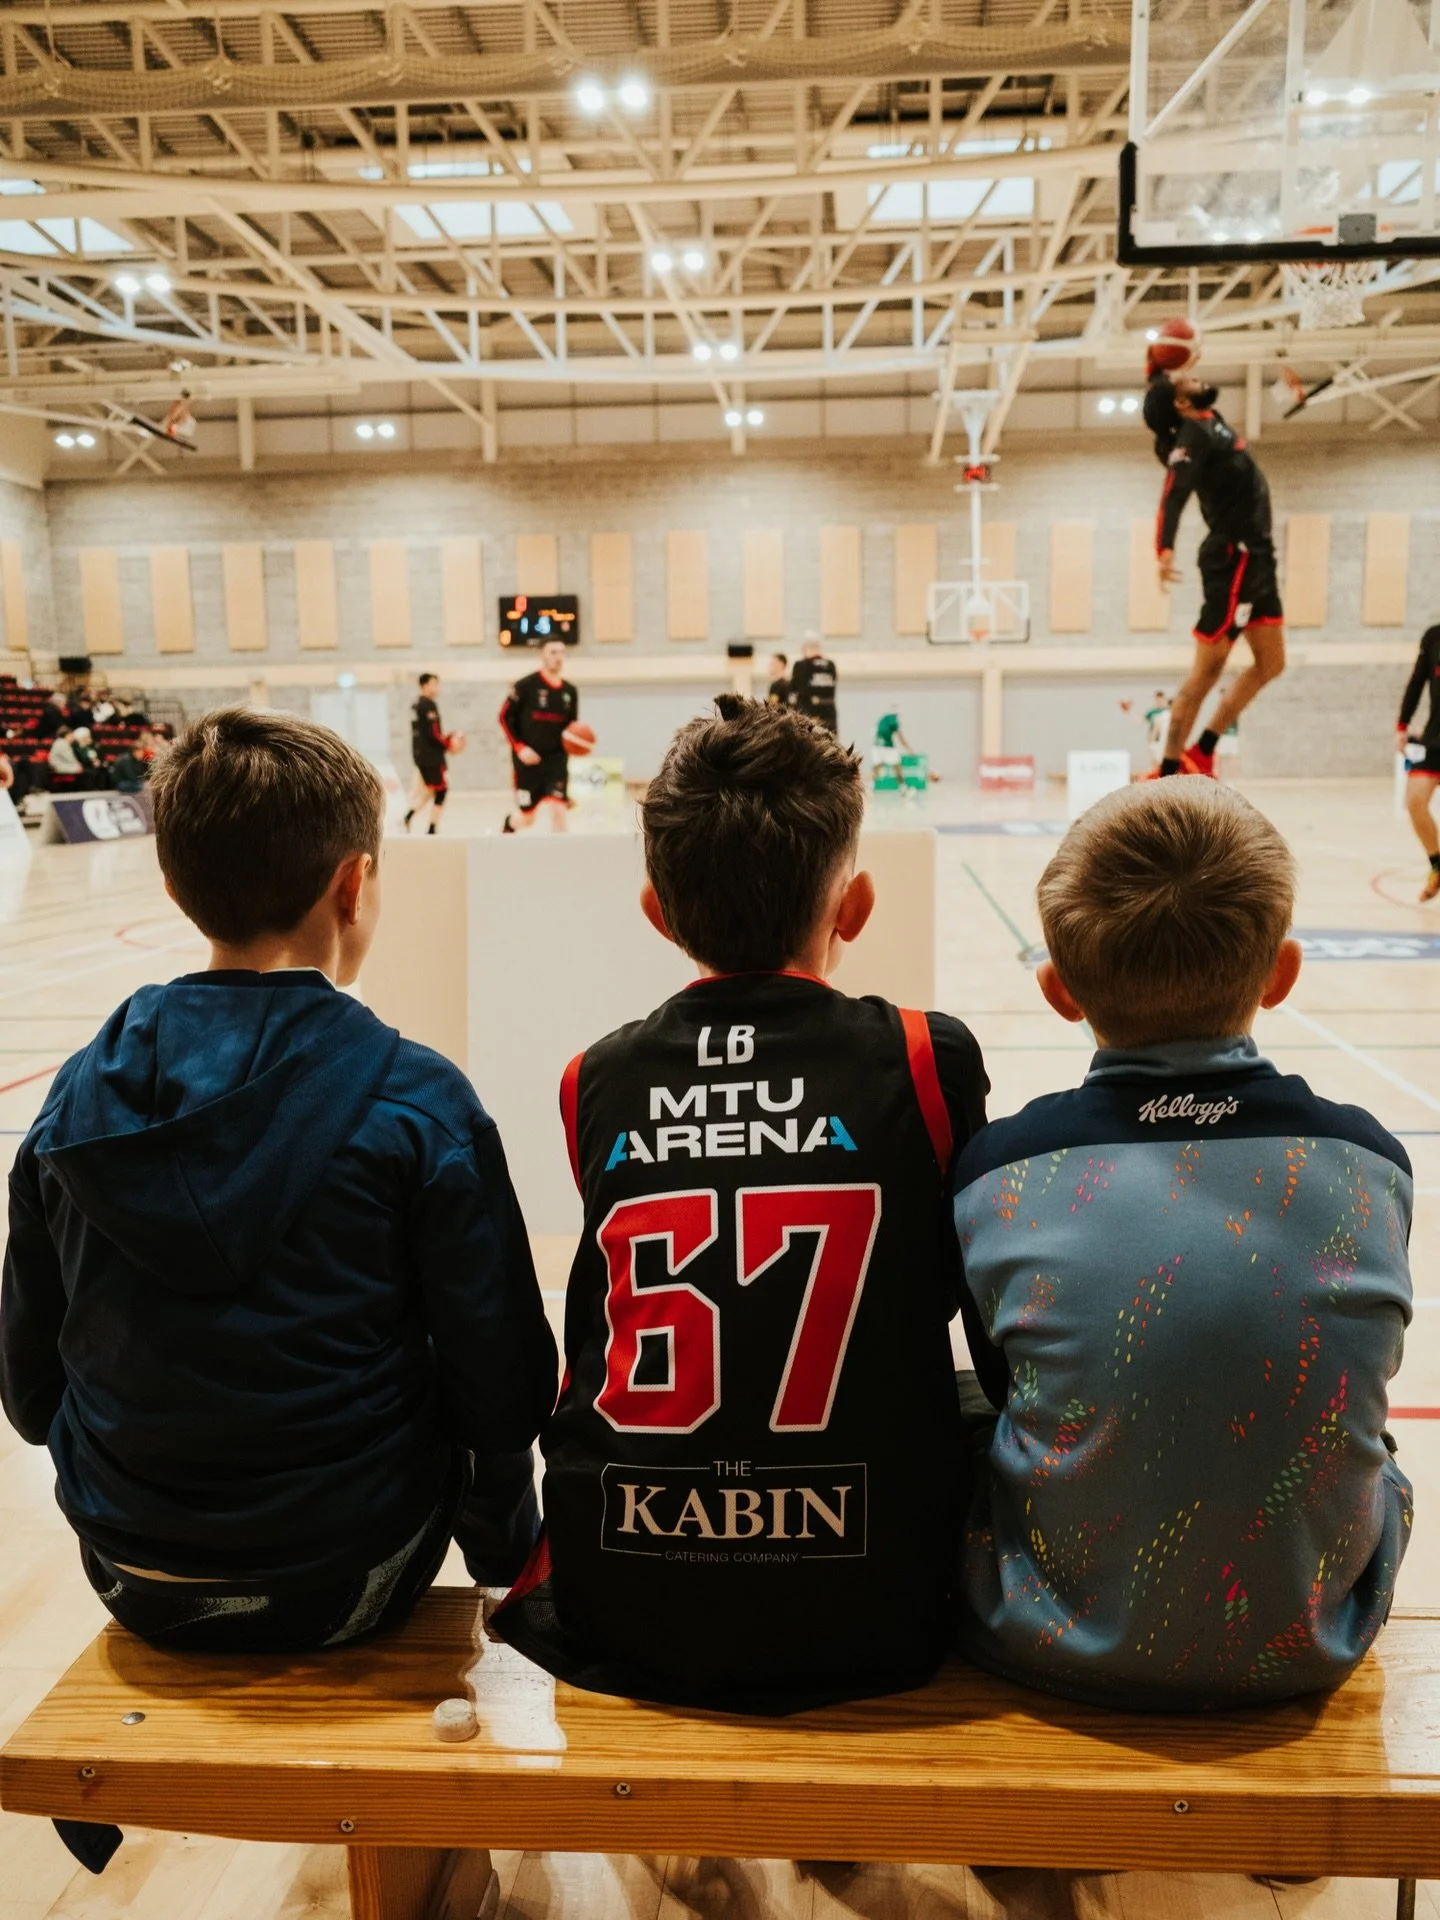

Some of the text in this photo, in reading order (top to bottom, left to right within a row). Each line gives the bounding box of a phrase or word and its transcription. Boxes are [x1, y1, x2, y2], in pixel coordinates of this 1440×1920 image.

[697, 1025, 756, 1067] LB
[649, 1077, 805, 1120] MTU
[1138, 1093, 1240, 1125] Kellogg's
[604, 1116, 858, 1172] ARENA
[593, 1182, 882, 1434] 67
[713, 1461, 752, 1477] THE
[616, 1483, 852, 1539] KABIN
[665, 1551, 799, 1563] CATERING COMPANY
